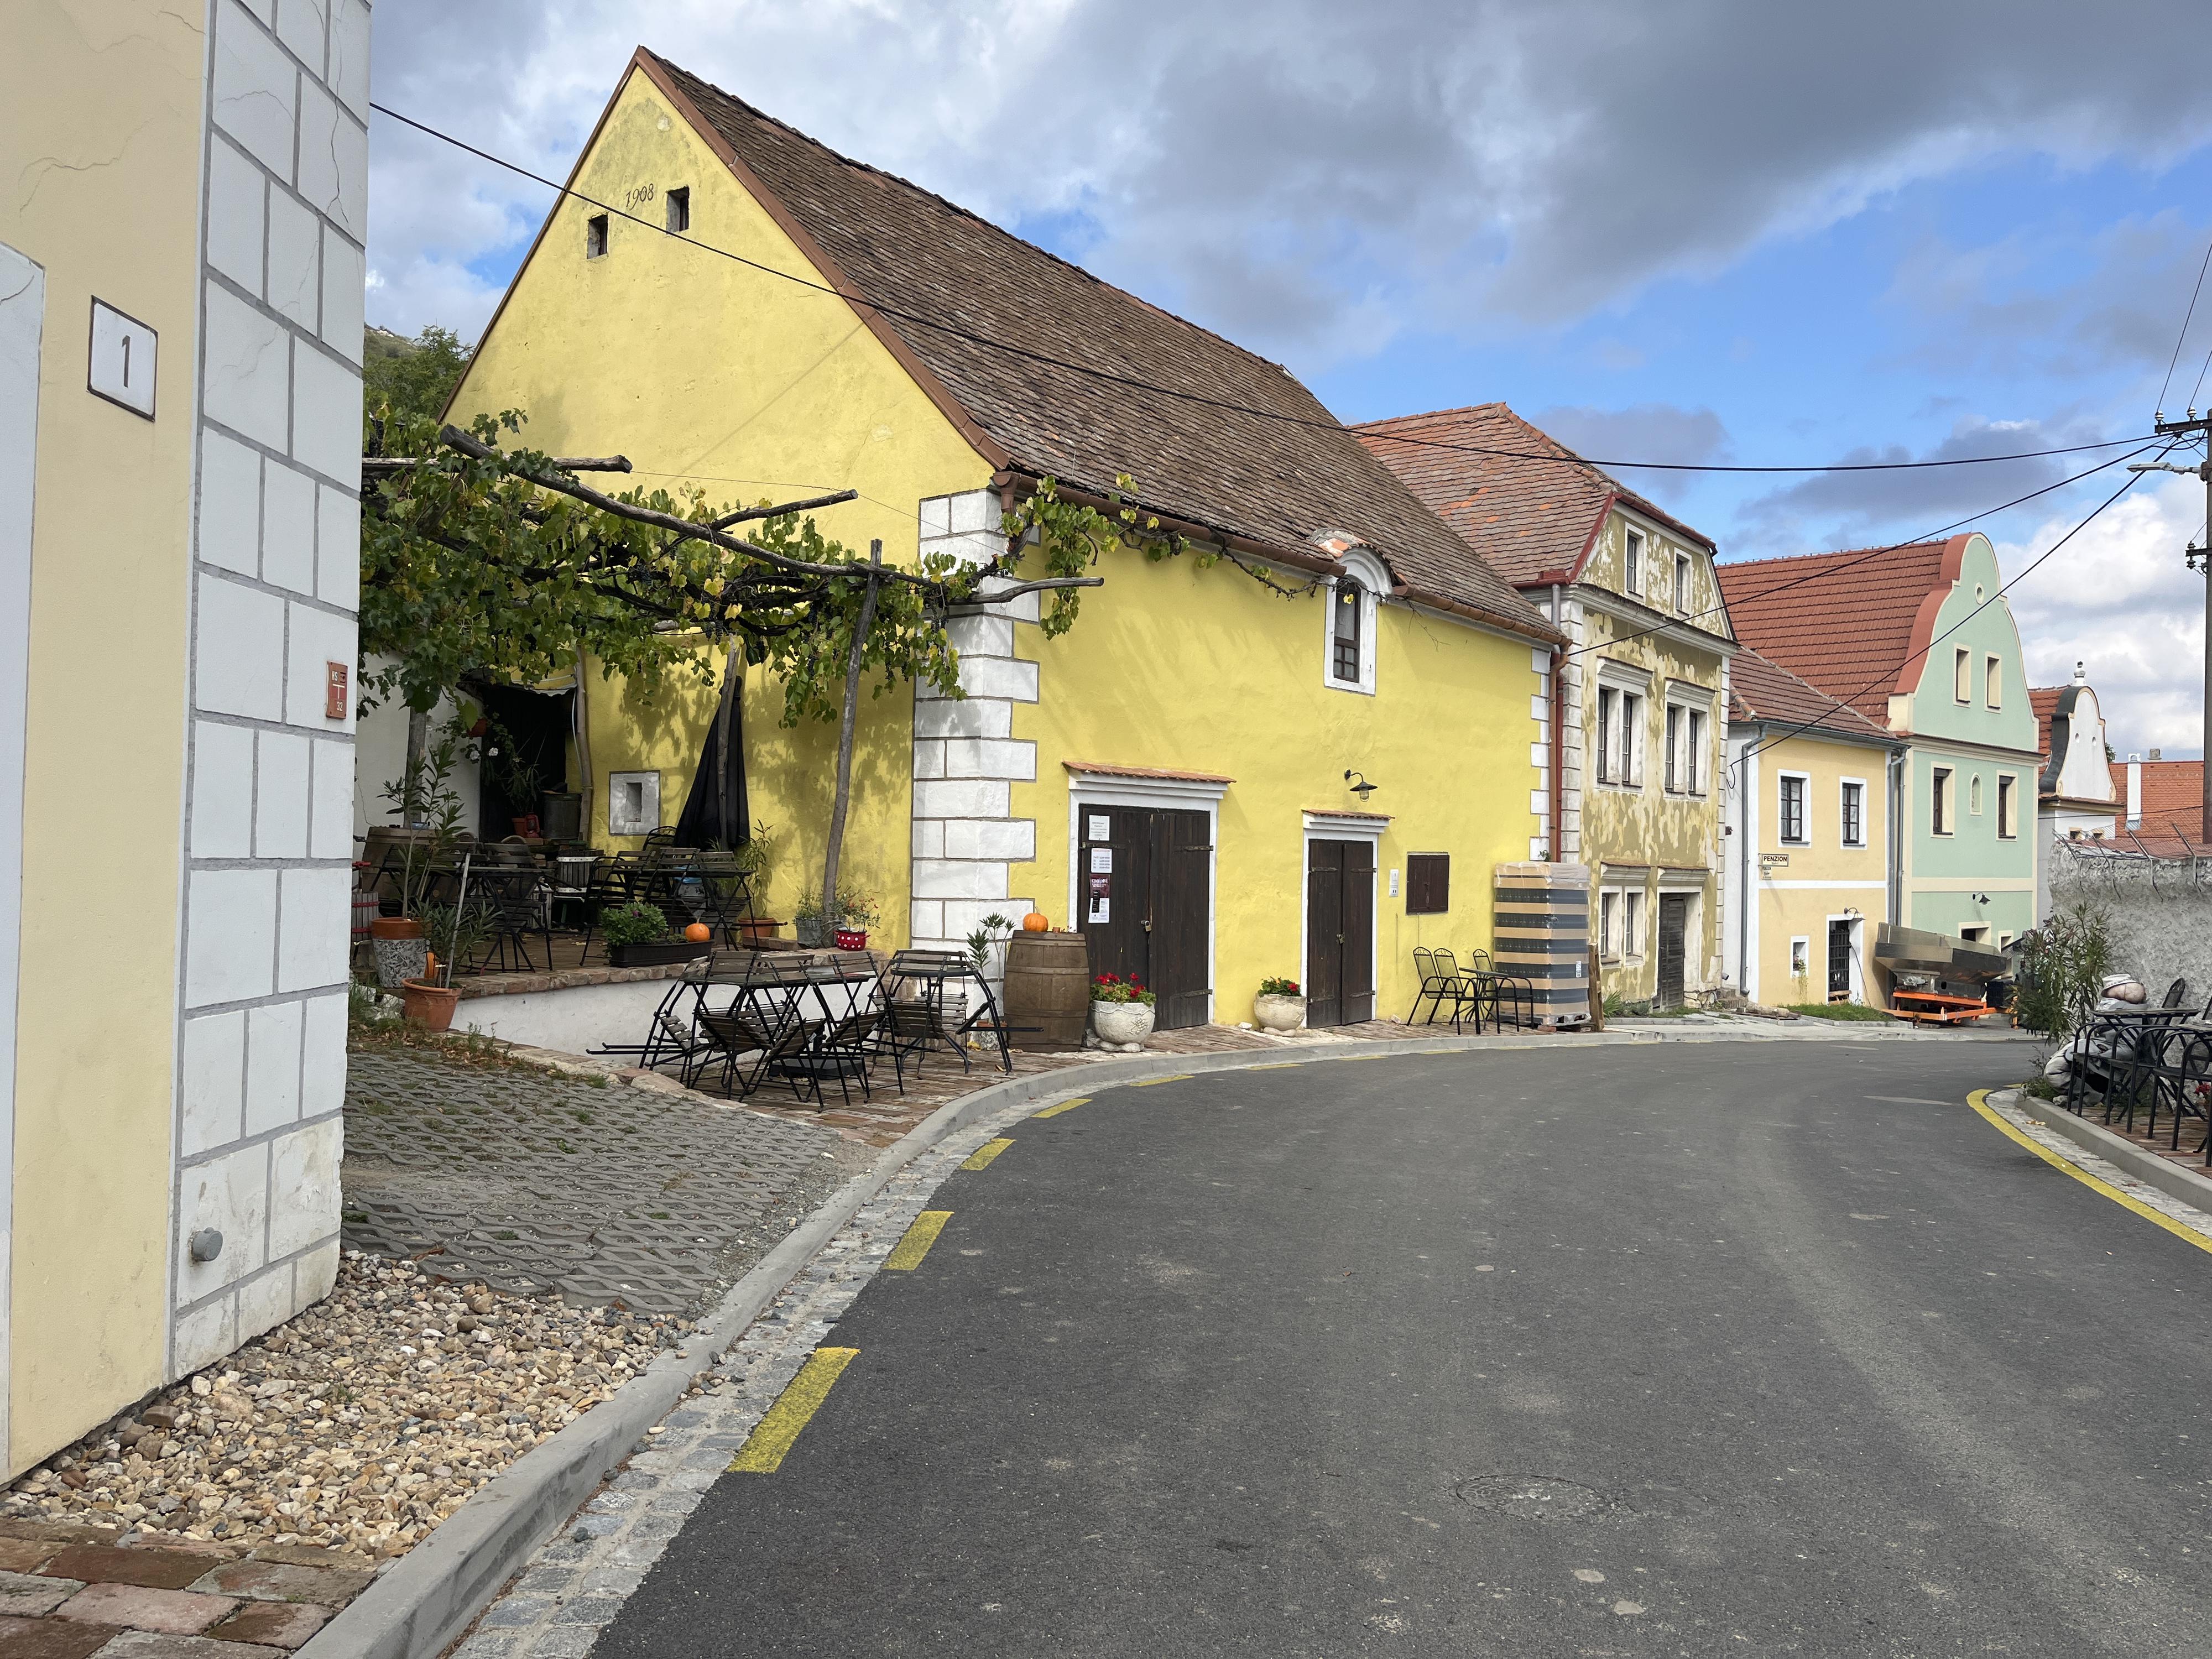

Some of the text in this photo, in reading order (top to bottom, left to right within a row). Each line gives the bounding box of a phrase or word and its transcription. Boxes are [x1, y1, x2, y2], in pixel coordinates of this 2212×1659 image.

[625, 183, 654, 211] 1908
[122, 335, 131, 388] 1
[336, 701, 343, 711] 32
